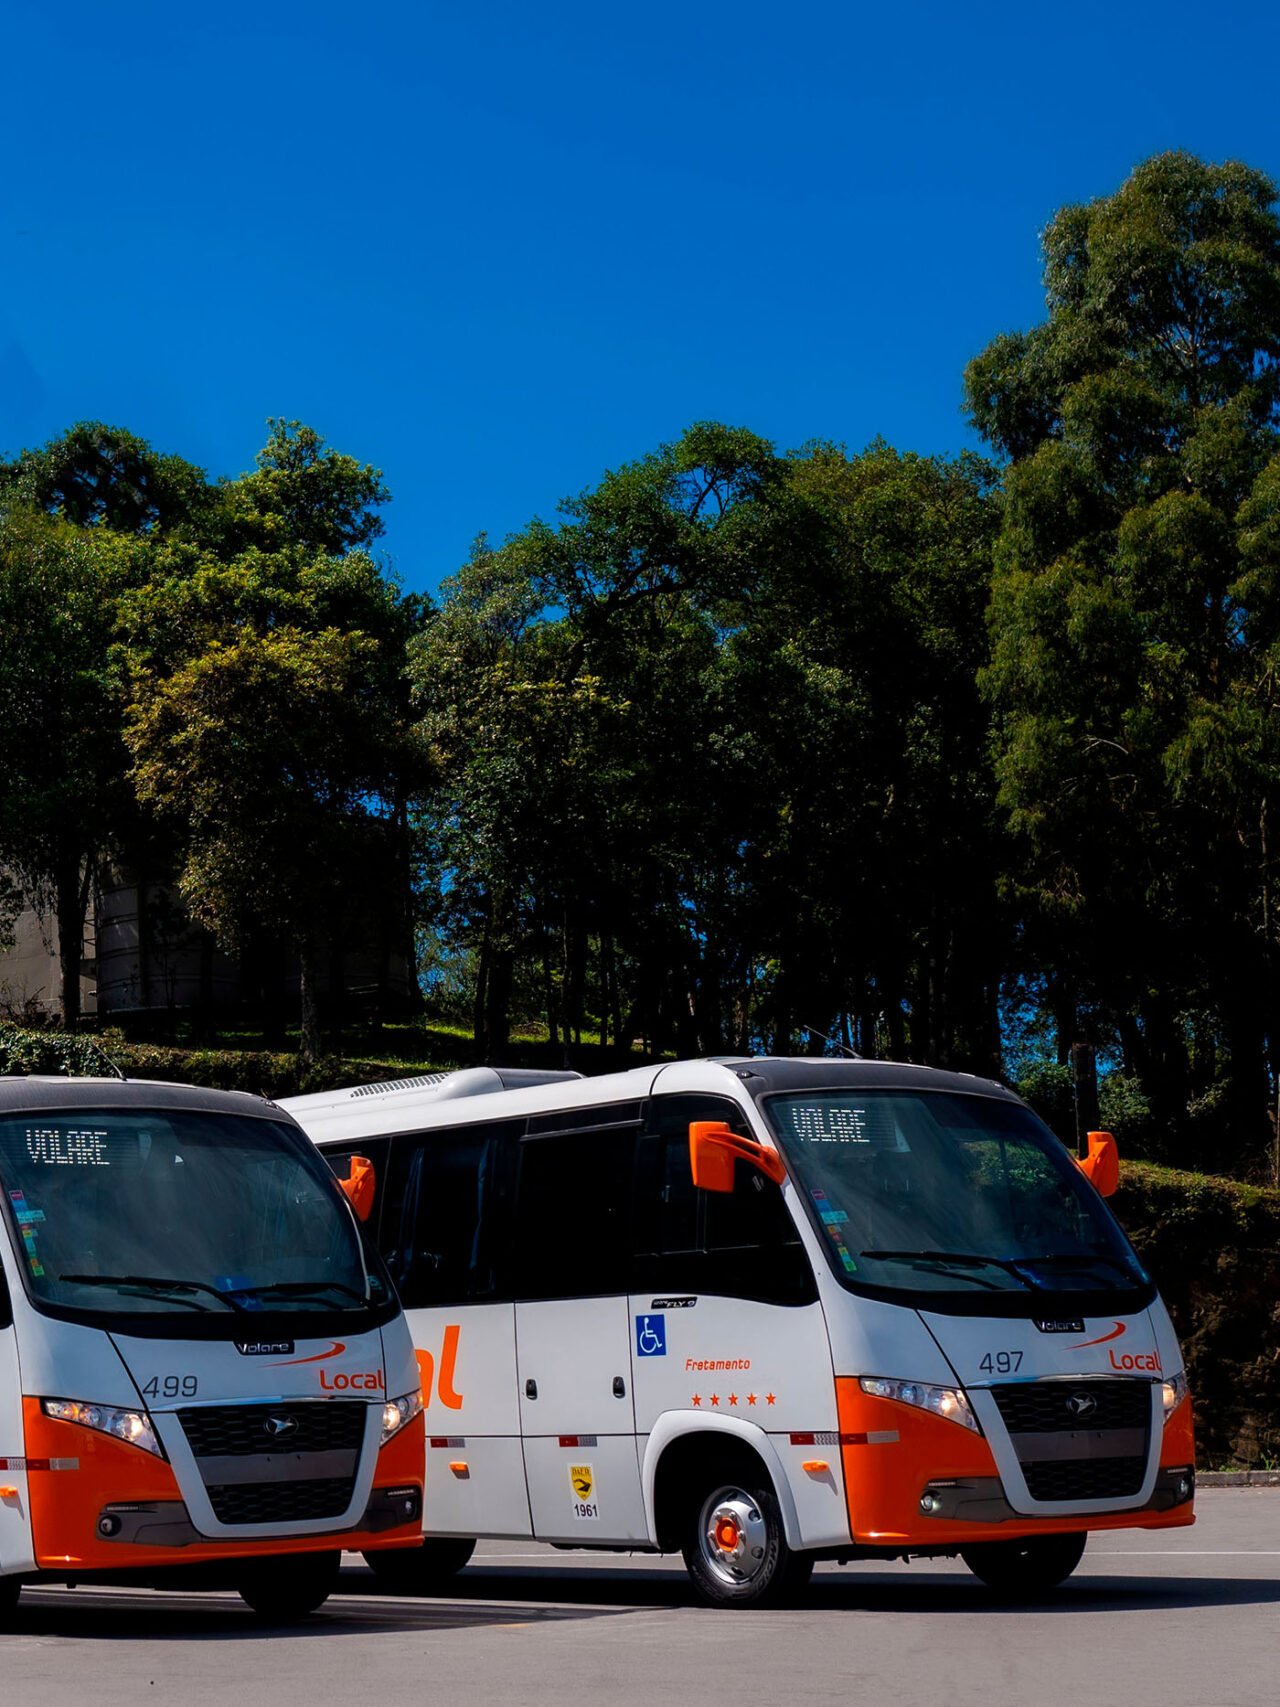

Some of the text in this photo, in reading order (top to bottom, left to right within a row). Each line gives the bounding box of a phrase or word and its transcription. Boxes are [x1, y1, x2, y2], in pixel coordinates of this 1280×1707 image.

[792, 1107, 870, 1143] VOLARE
[25, 1129, 111, 1165] VOLARE
[1037, 1319, 1082, 1331] Volare
[237, 1342, 291, 1354] Volare
[685, 1359, 751, 1371] Fretamento
[979, 1351, 1025, 1374] 497
[1109, 1350, 1162, 1371] Local
[142, 1375, 198, 1399] 499
[319, 1369, 386, 1391] Local
[574, 1503, 598, 1518] 1961
